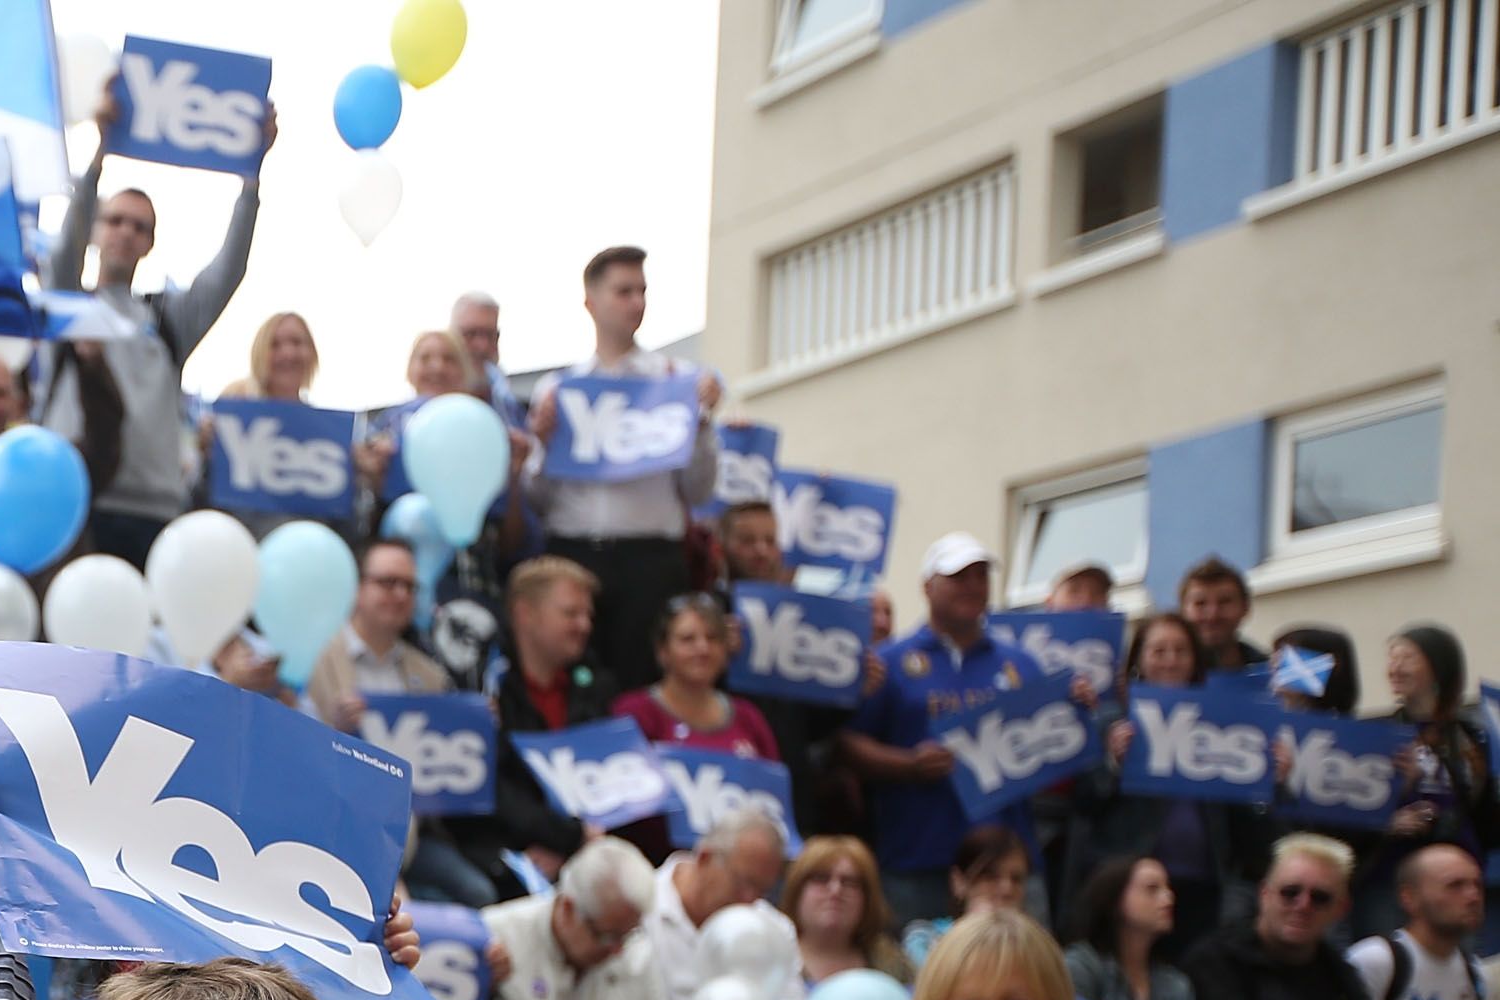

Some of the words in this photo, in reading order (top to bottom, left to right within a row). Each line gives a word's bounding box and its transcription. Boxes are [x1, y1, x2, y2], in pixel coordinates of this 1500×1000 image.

[124, 54, 261, 158] Yes
[215, 412, 348, 498] Yes
[562, 389, 692, 464] Yes
[773, 483, 885, 562] Yes
[740, 599, 863, 688] Yes
[361, 711, 486, 795] Yes
[524, 747, 665, 818] Yes
[942, 702, 1087, 794] Yes
[1132, 698, 1267, 785] Yes
[1277, 724, 1393, 811] Yes
